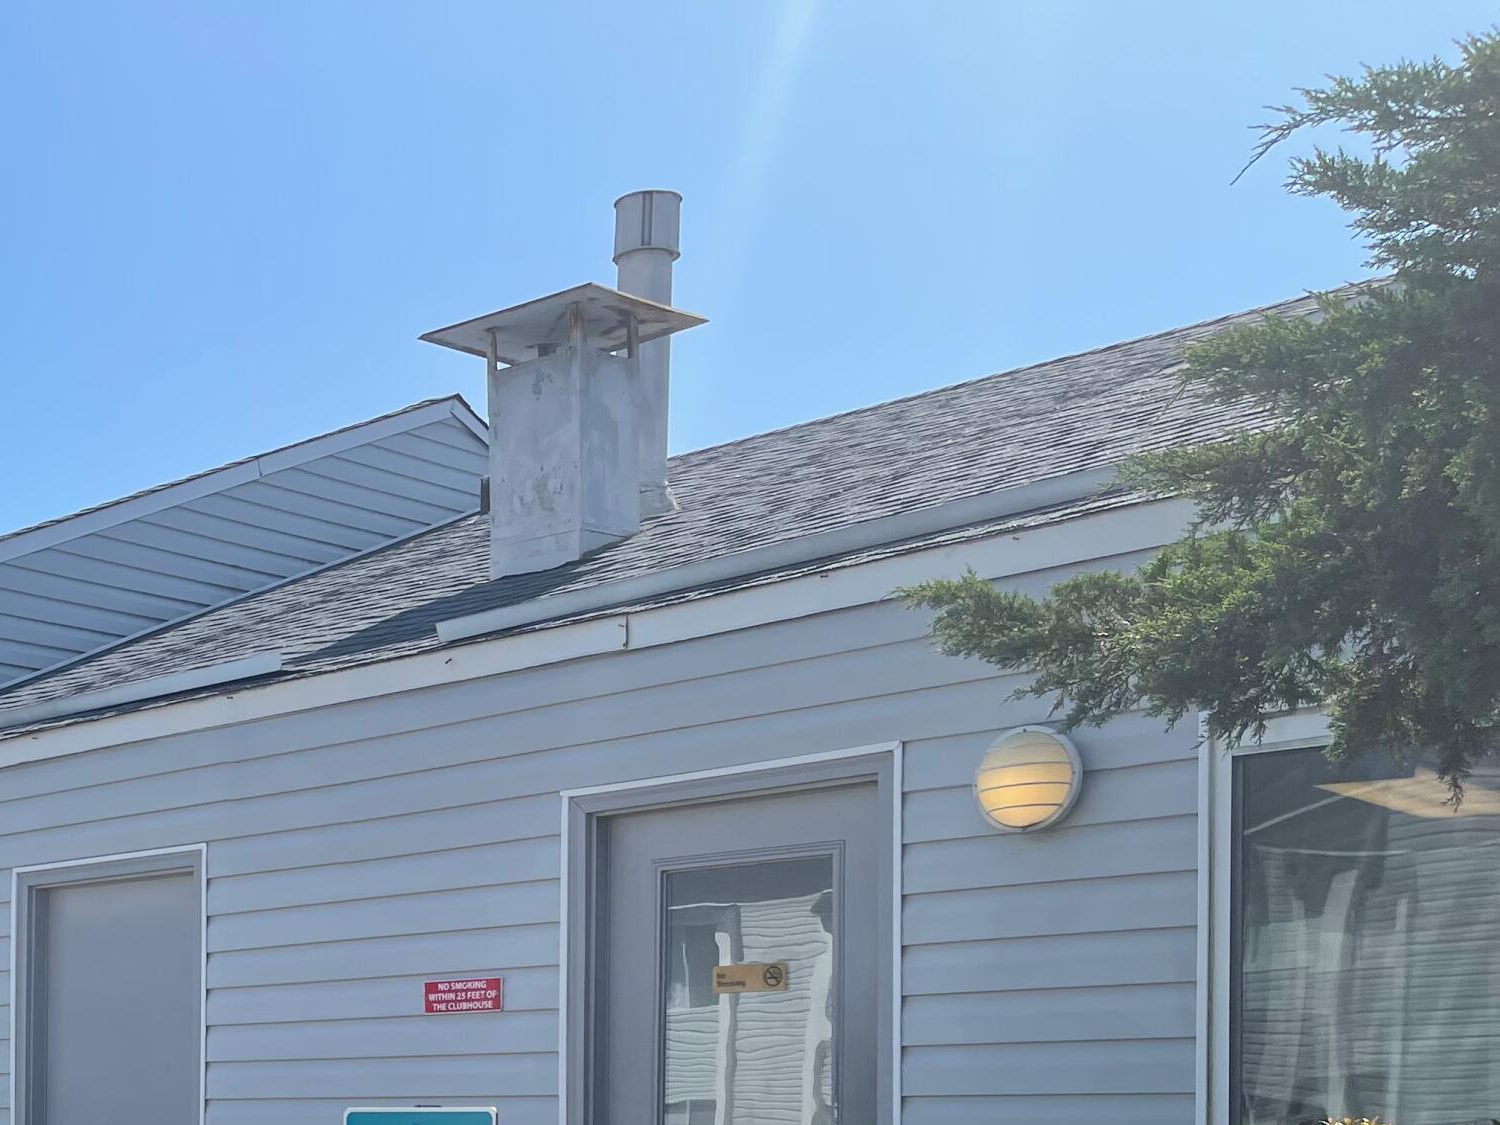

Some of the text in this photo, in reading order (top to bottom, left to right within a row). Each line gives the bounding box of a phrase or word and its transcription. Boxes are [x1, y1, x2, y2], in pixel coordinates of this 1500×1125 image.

[438, 981, 486, 991] NO SMOKING
[428, 993, 455, 1001] WITHIN
[467, 990, 485, 999] FEET
[486, 990, 497, 999] OF
[433, 1000, 493, 1011] THE CLUBHOUSE
